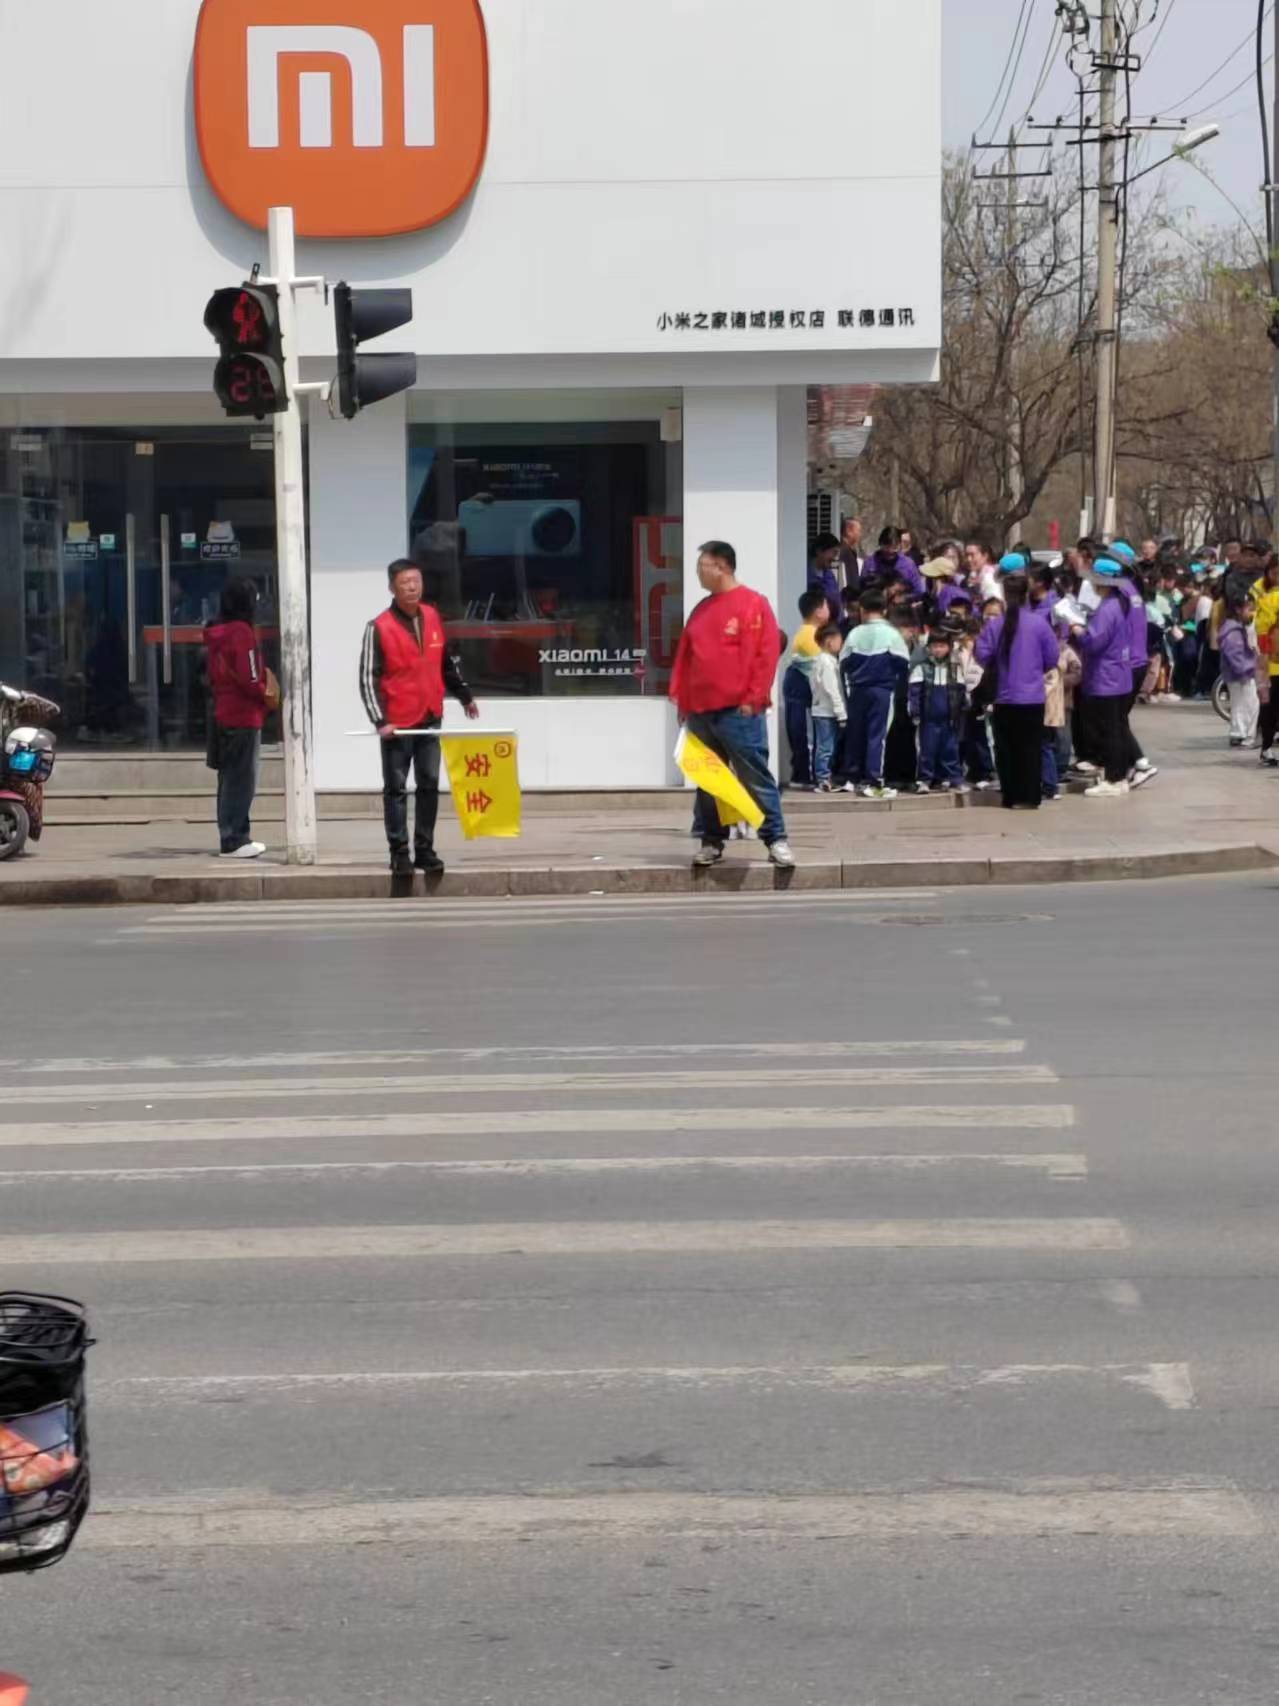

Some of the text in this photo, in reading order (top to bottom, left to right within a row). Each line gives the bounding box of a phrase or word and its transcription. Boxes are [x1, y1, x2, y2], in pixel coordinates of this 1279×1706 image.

[656, 310, 826, 331] 小米之家诸城授权店
[614, 648, 630, 661] 14
[464, 752, 494, 814] 安全
